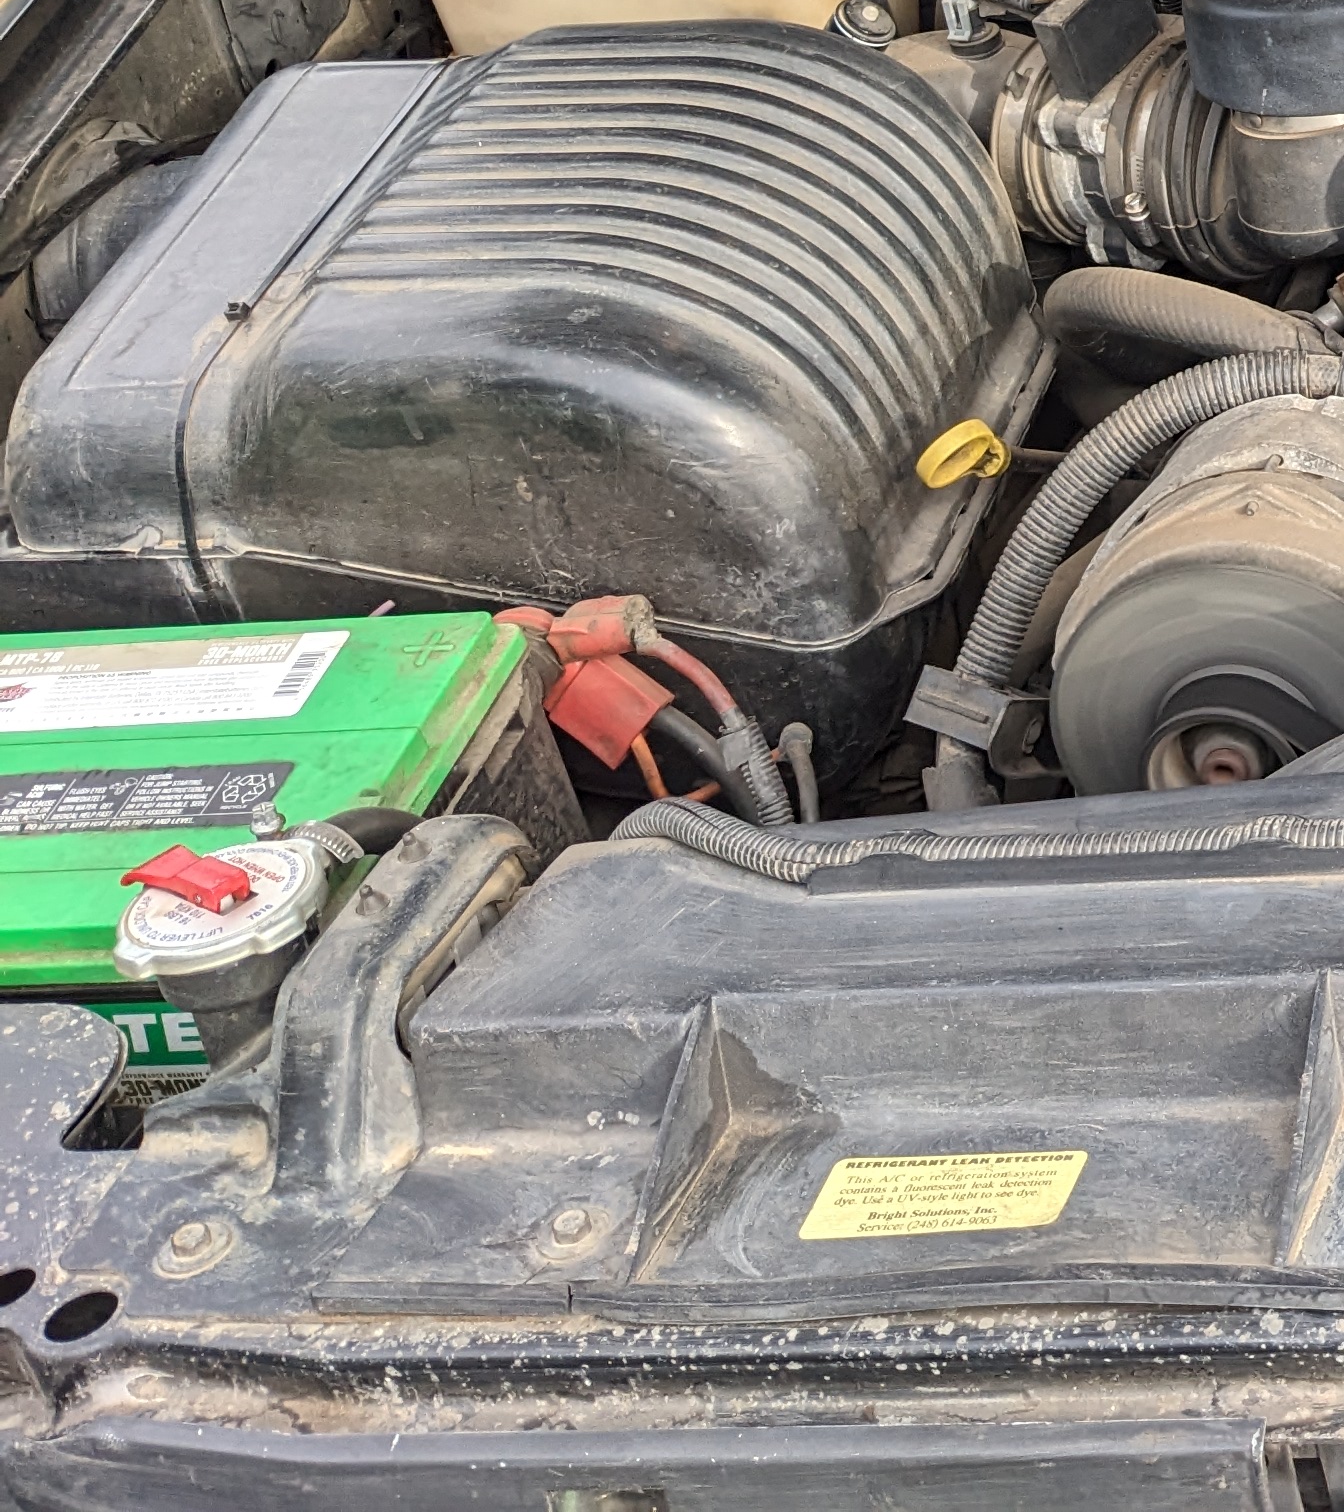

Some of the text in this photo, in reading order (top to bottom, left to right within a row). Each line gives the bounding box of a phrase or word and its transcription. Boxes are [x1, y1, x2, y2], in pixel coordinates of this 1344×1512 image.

[202, 643, 293, 659] 30-MONTH
[198, 655, 286, 666] FREE REPLACEMENT
[161, 932, 197, 943] LEVER
[200, 926, 224, 940] LIFT
[845, 1154, 1075, 1169] REFRIGERANT LEAK DETECTION
[847, 1169, 1058, 1185] This A/C or refrigeration system
[839, 1185, 888, 1195] contains
[904, 1182, 967, 1193] fluorescent
[971, 1180, 995, 1189] leak
[999, 1179, 1053, 1188] detection
[834, 1196, 858, 1208] dye.
[862, 1195, 884, 1205] Use
[897, 1192, 949, 1204] UV-style
[951, 1191, 978, 1202] light
[980, 1191, 993, 1200] to
[995, 1191, 1014, 1199] see
[1016, 1188, 1040, 1199] dye.
[867, 1206, 998, 1222] Bright Solutions, Inc.
[906, 1218, 939, 1232] (248)
[941, 1215, 998, 1228] 614-9063
